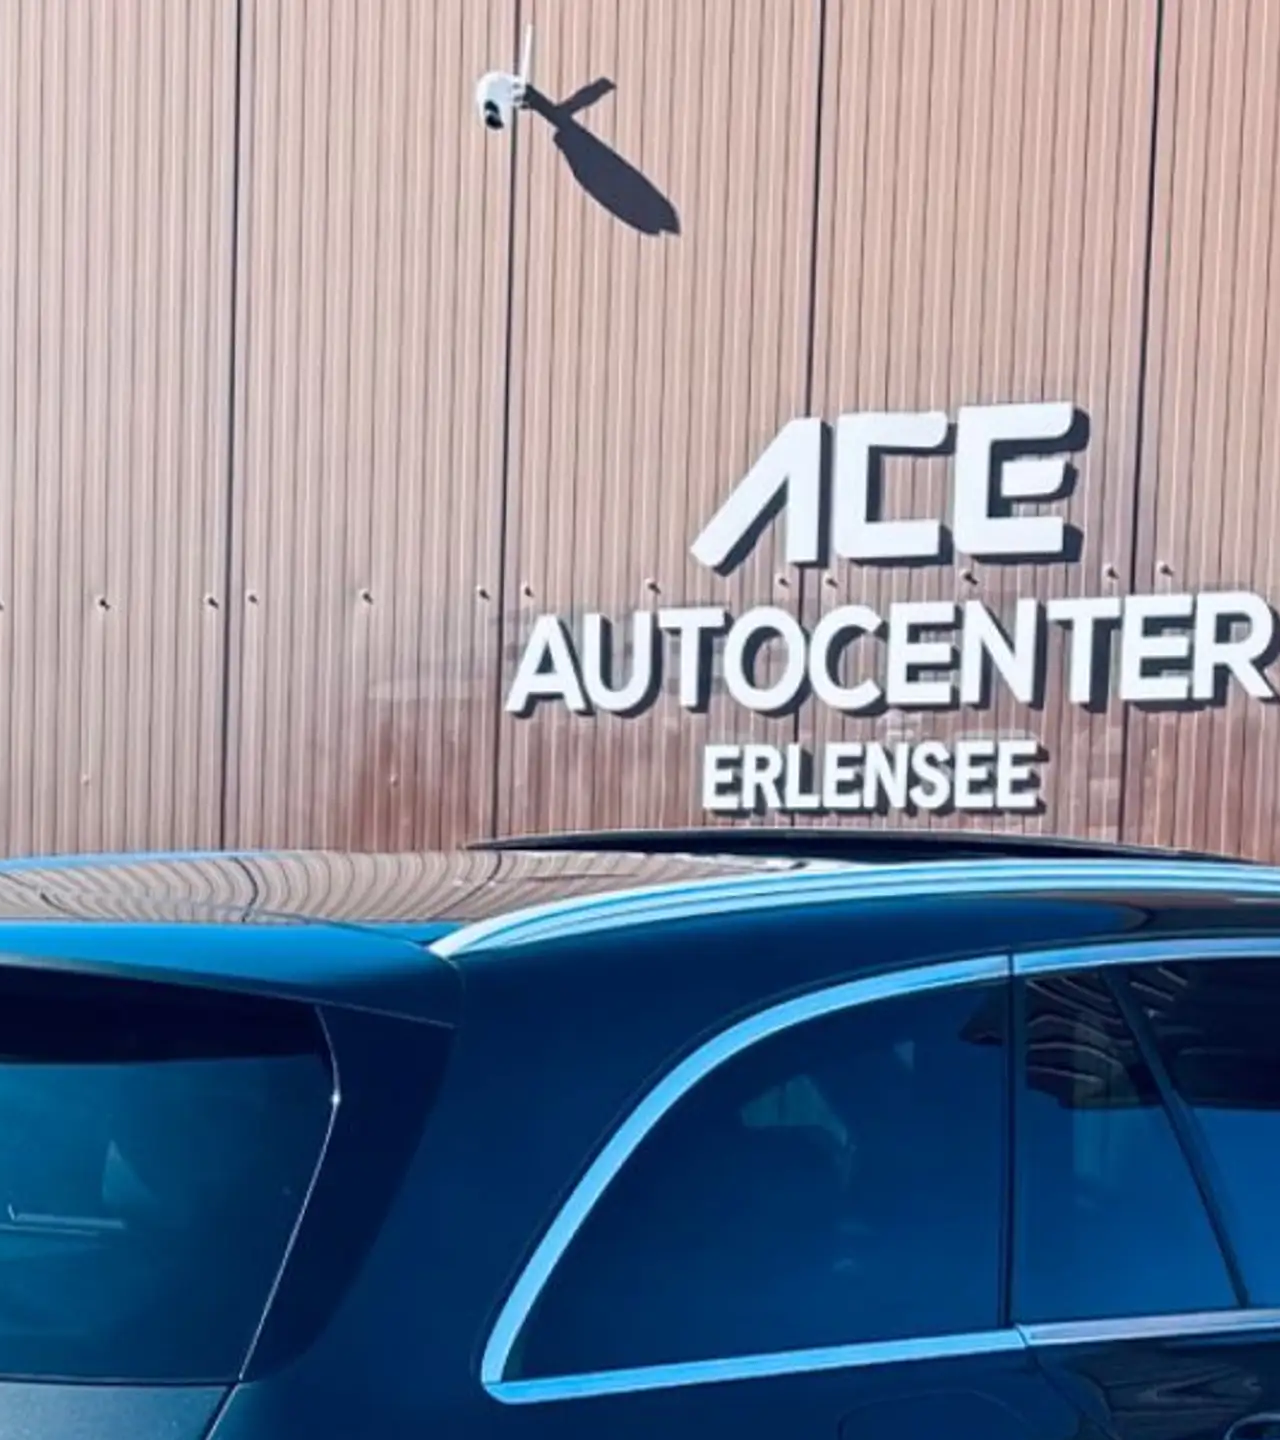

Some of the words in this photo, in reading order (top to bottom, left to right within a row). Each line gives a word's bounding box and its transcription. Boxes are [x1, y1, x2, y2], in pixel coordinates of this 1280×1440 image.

[690, 402, 1075, 574] ACE
[505, 591, 1277, 714] AUTOCENTER
[702, 740, 1040, 811] ERLENSEE
